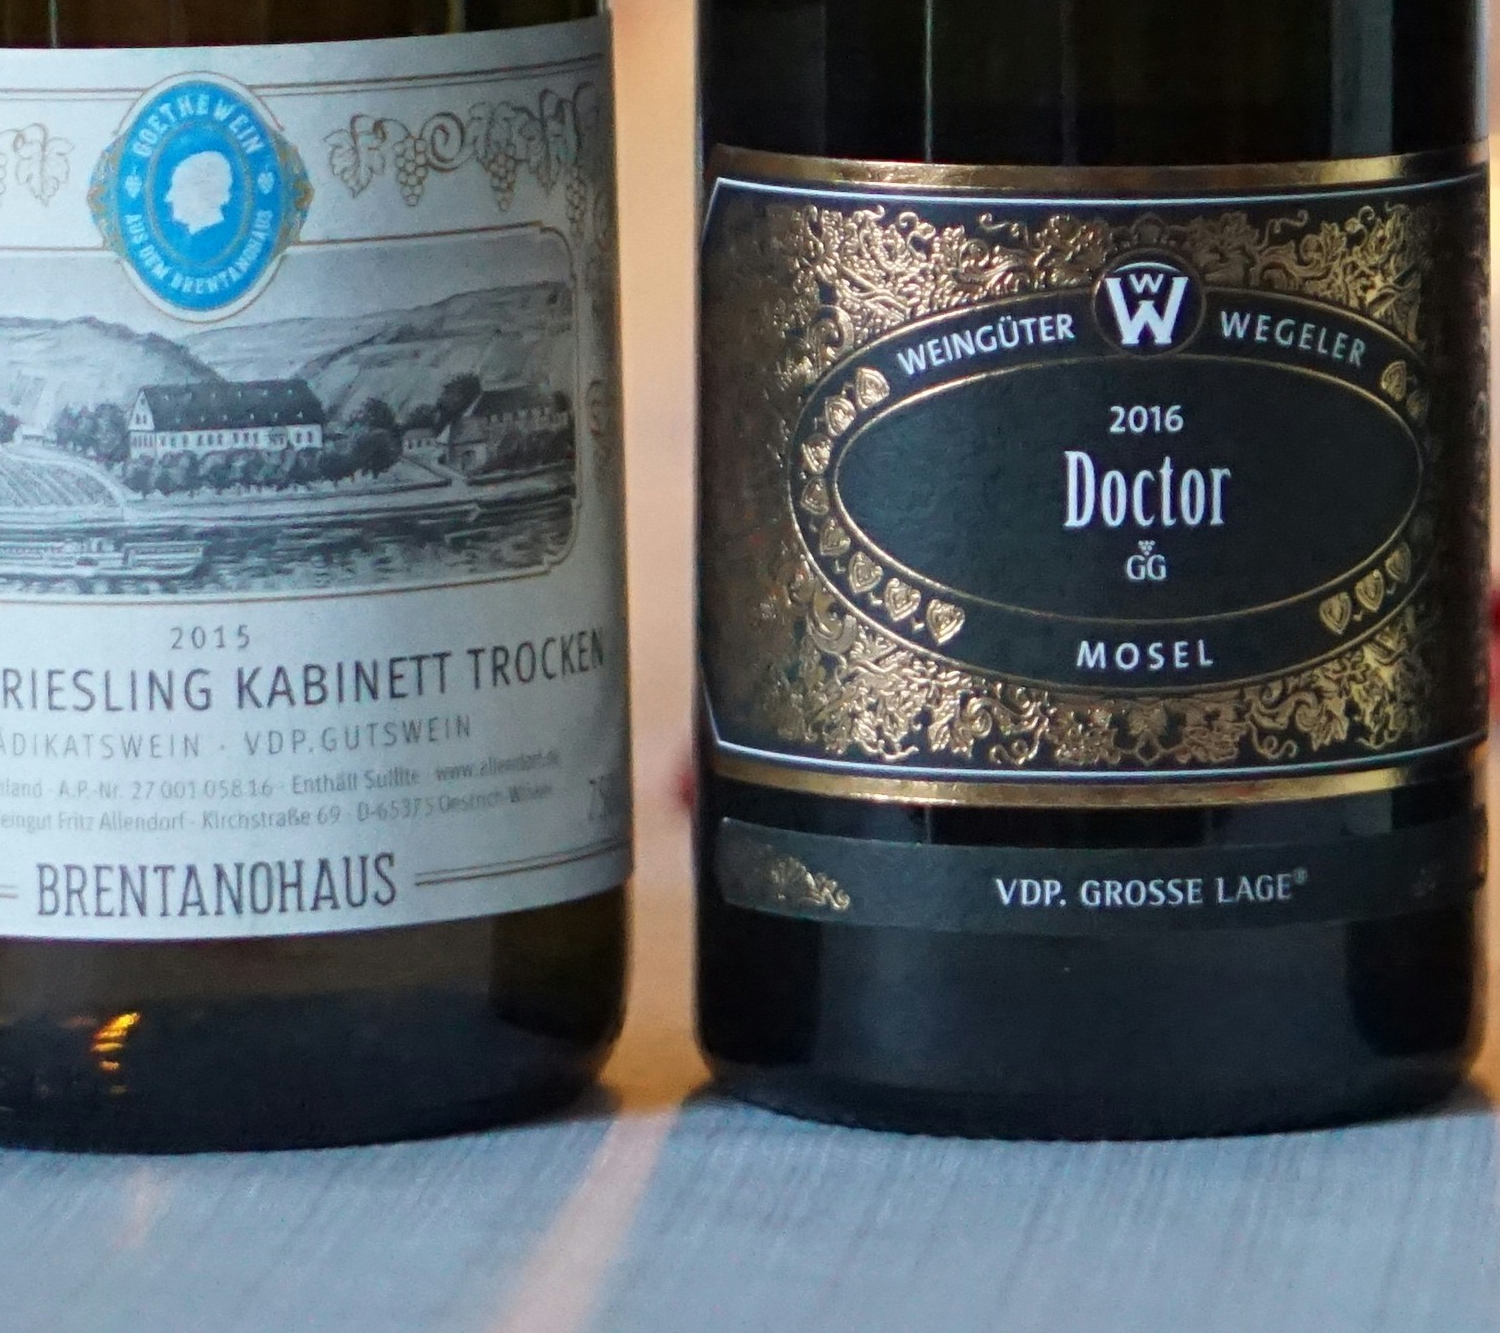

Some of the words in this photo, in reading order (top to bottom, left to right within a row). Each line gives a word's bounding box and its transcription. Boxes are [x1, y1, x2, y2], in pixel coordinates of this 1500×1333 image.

[897, 311, 1076, 377] WEINGÜTER
[1219, 308, 1368, 368] WEGELER
[1108, 404, 1185, 434] 2016
[1062, 450, 1232, 530] Doctor
[1124, 553, 1169, 583] GG
[169, 624, 252, 652] 2015
[1, 666, 213, 713] RIESLING
[235, 648, 456, 711] KABINETT
[465, 627, 606, 692] TROCKEN
[1075, 638, 1215, 671] MOSEL
[56, 809, 95, 831] Fritz
[98, 808, 185, 832] Allendorf
[35, 852, 398, 921] BRENTANOHAUS
[995, 876, 1069, 908] VDP.
[1079, 876, 1205, 908] GROSSE
